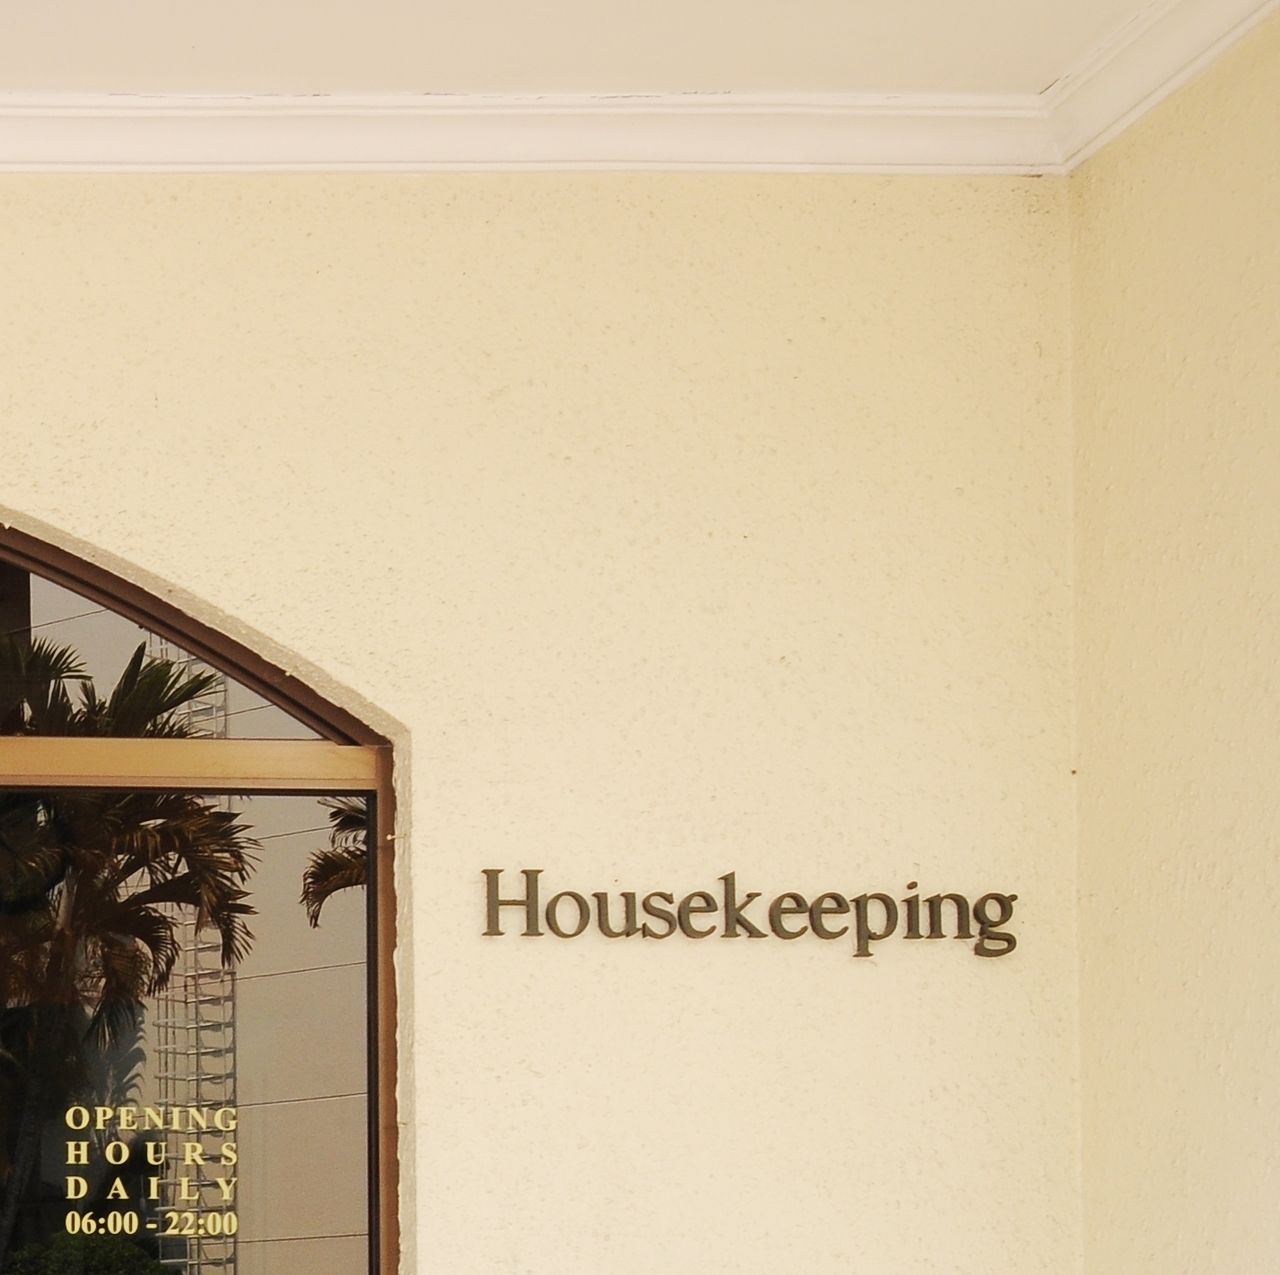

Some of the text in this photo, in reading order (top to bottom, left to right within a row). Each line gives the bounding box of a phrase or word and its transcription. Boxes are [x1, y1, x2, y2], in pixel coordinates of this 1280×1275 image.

[481, 868, 1018, 958] Housekeeping
[65, 1106, 238, 1131] OPENING
[65, 1141, 237, 1165] HOURS
[65, 1176, 237, 1200] DAILY
[65, 1210, 139, 1235] 06:00
[165, 1211, 238, 1236] 22:00
